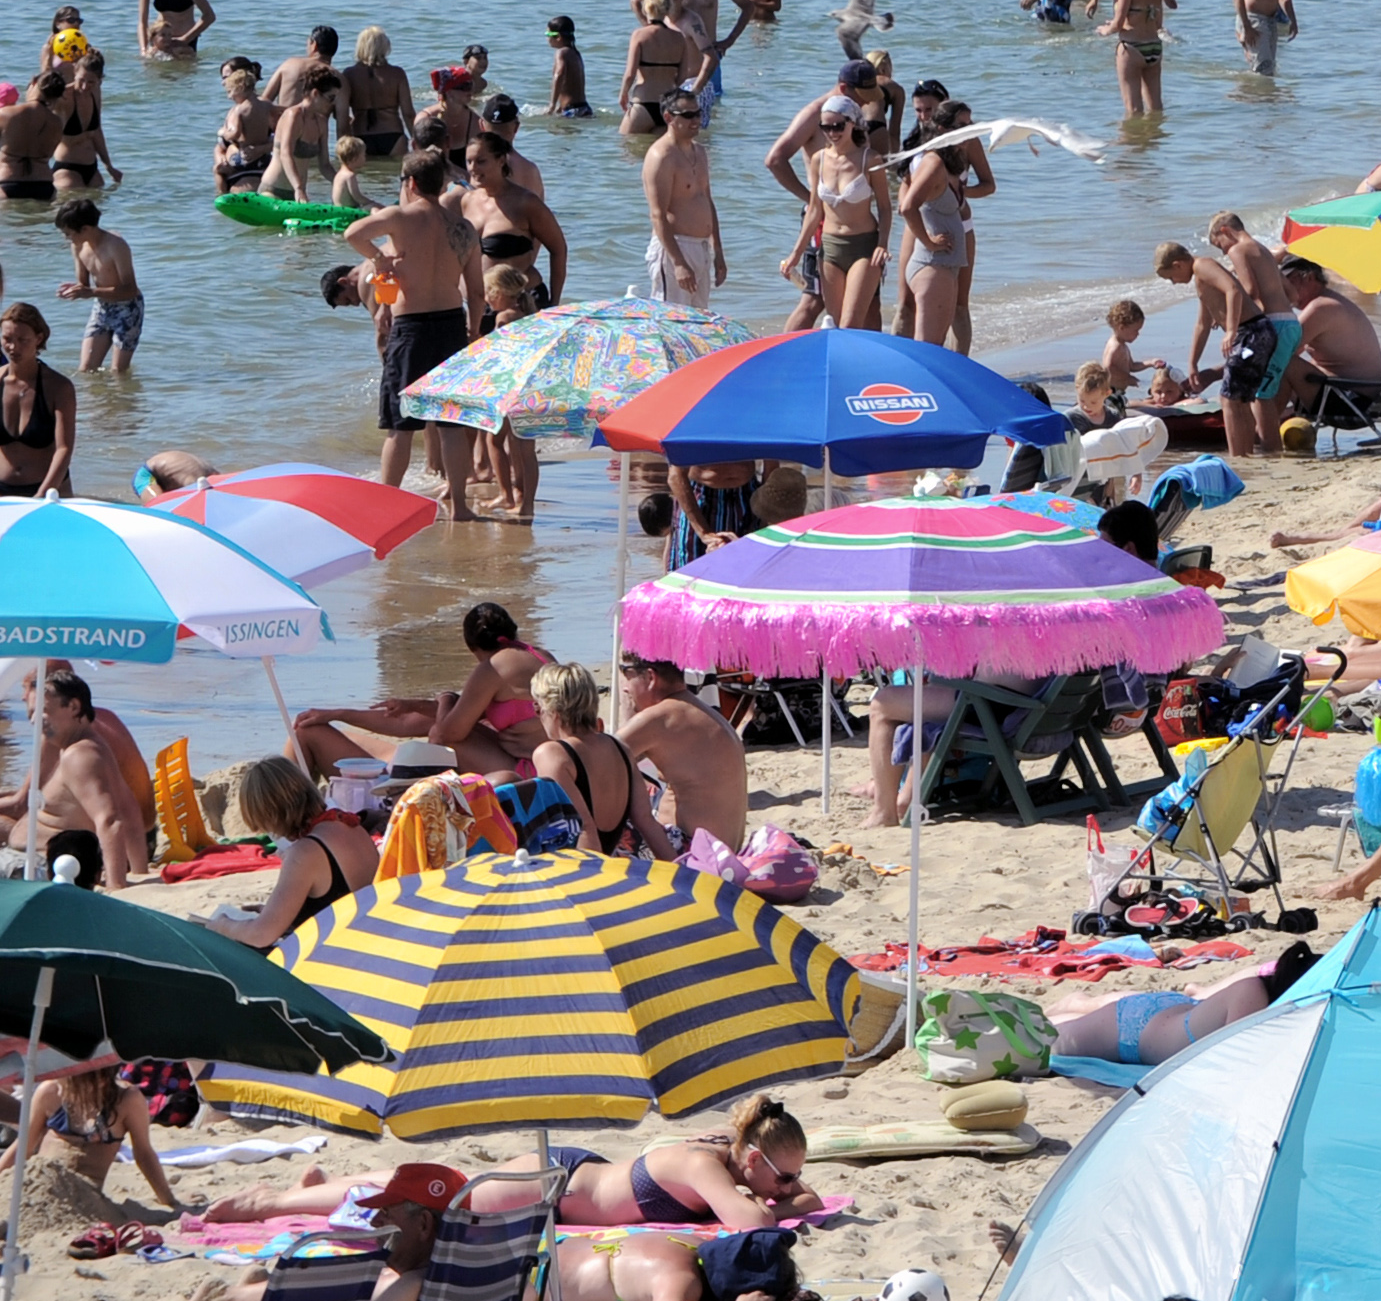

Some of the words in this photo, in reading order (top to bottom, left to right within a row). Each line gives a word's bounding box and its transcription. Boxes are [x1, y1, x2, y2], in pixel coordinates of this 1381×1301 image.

[852, 397, 930, 410] NISSAN
[225, 619, 300, 644] ISSINGEN
[1163, 704, 1200, 720] Coca-Cola
